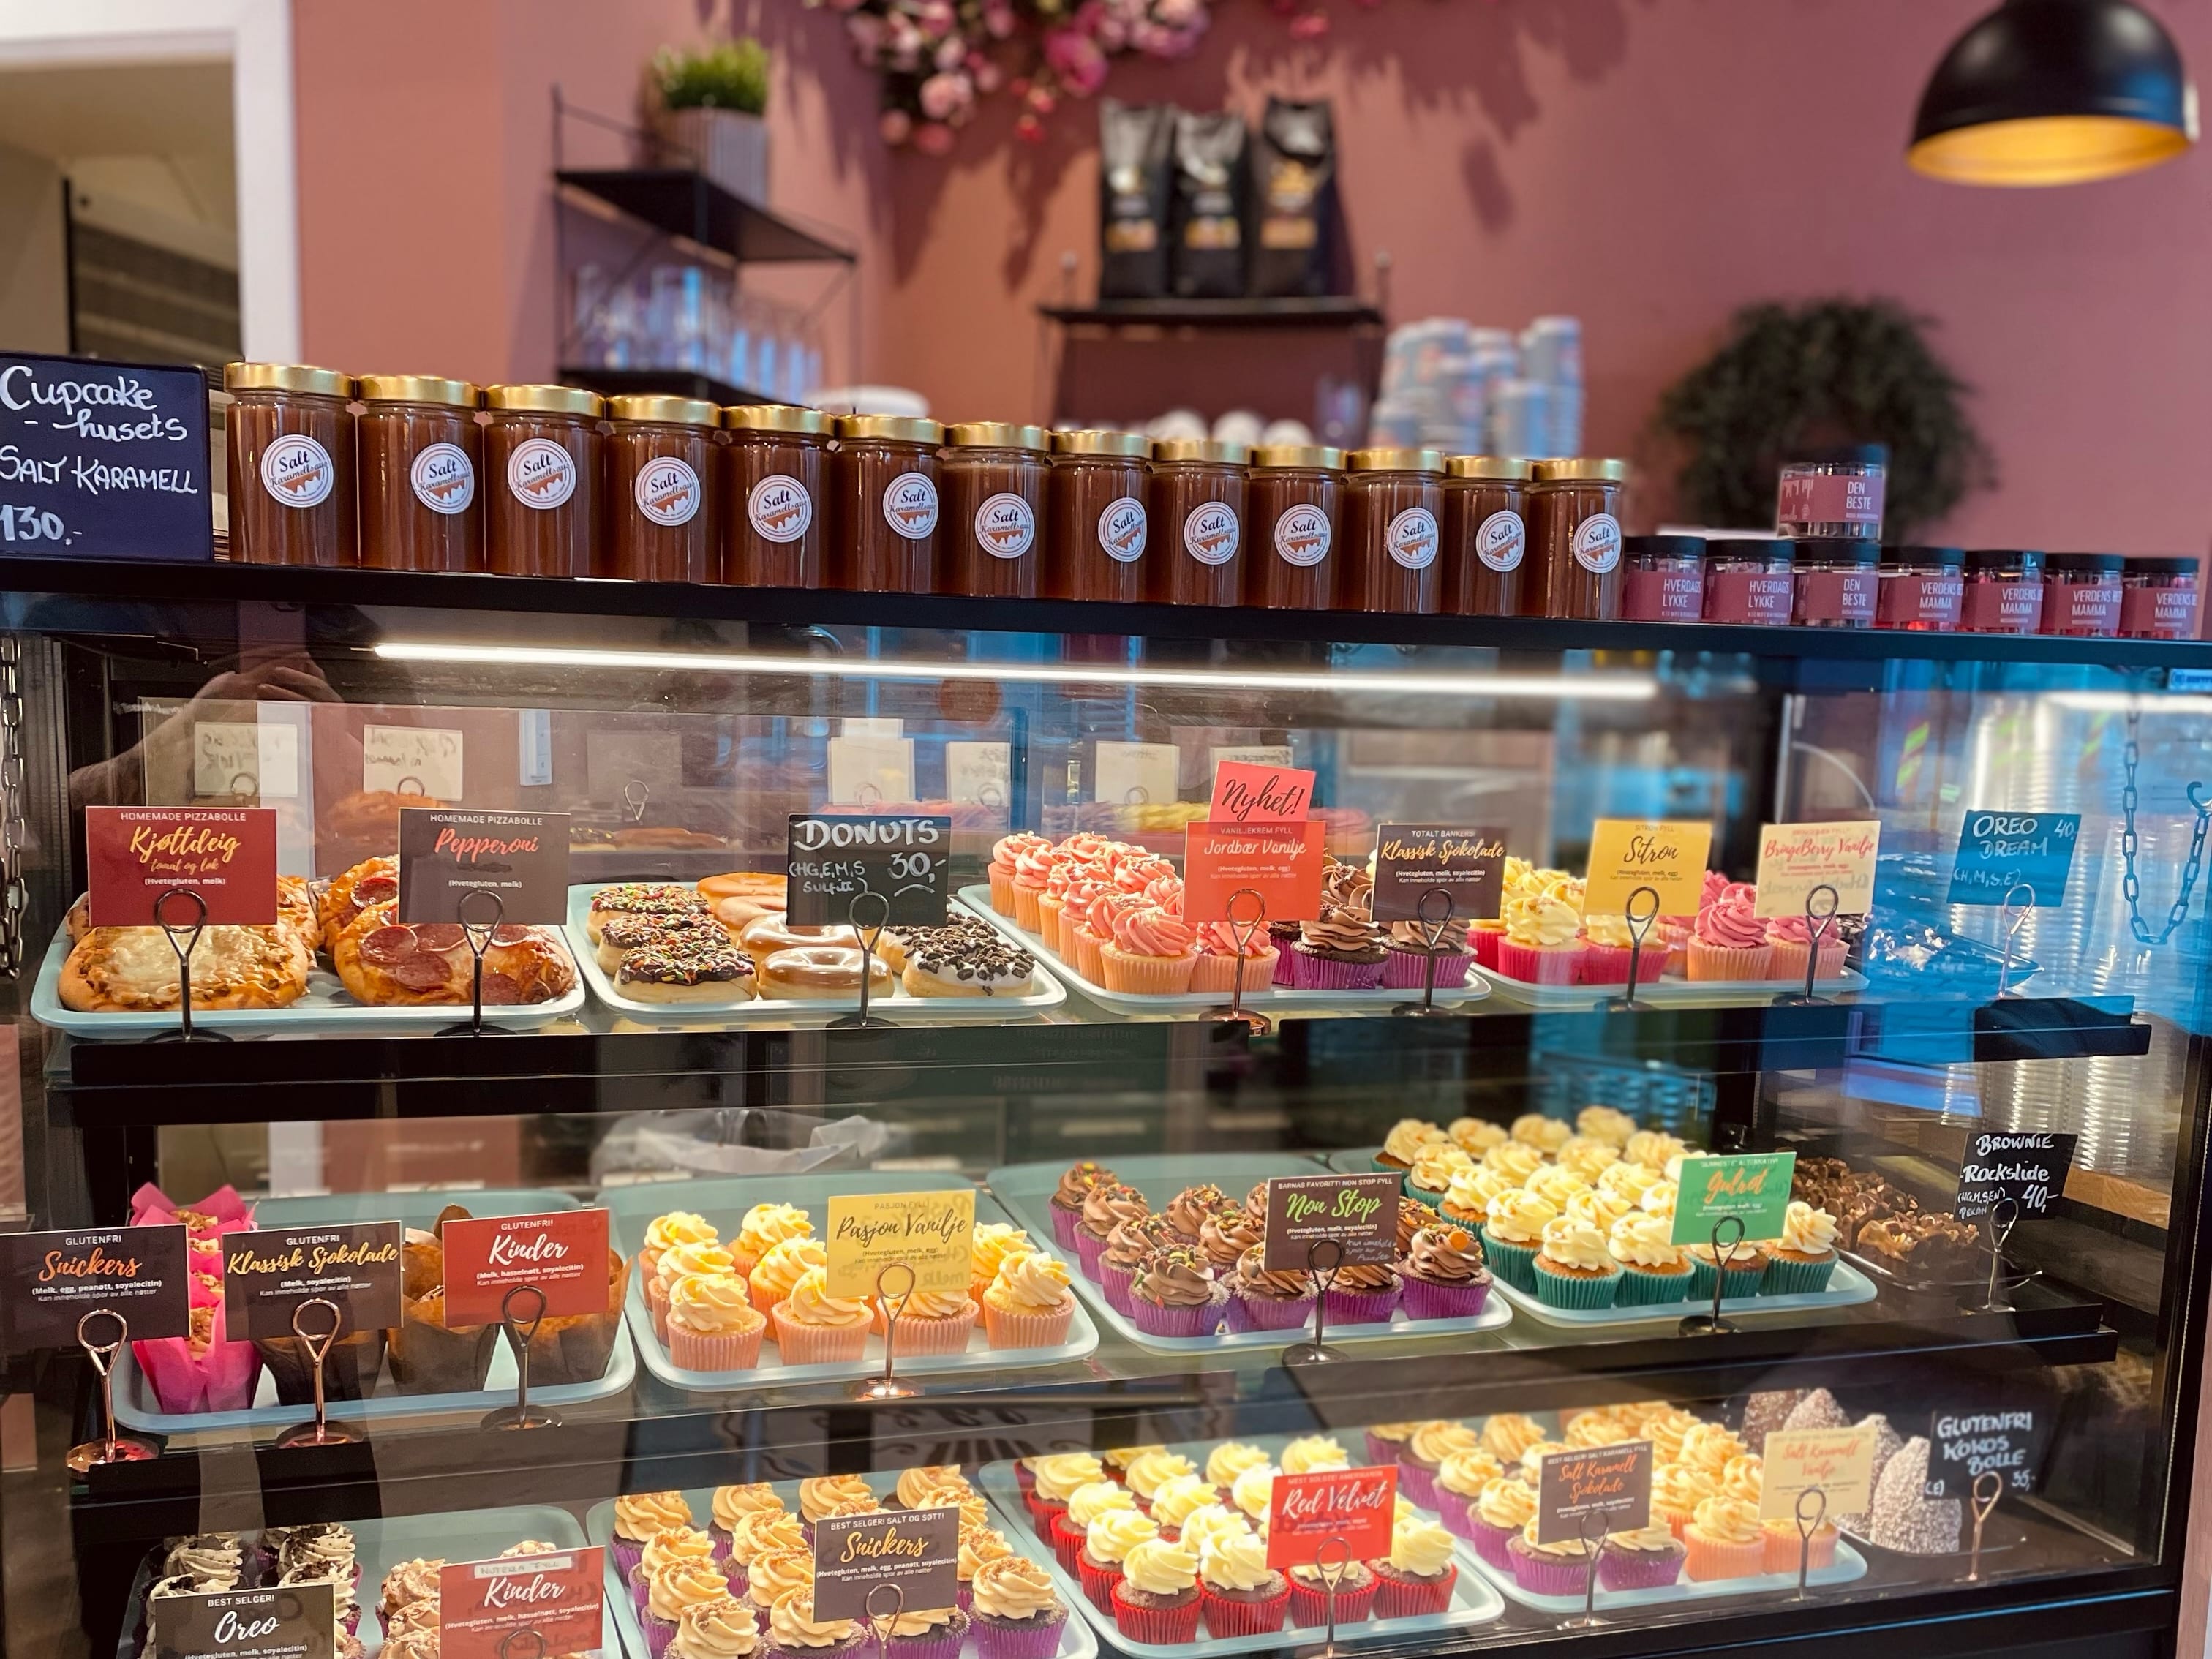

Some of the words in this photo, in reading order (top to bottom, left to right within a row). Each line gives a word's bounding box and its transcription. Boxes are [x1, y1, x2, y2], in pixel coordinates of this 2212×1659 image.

[0, 366, 157, 415] Cupcake
[53, 408, 188, 442] husets
[0, 445, 67, 484] SALT
[71, 456, 198, 495] KARAMELL
[279, 451, 310, 472] Salt
[429, 459, 457, 478] Salt
[524, 454, 552, 476] Salt
[651, 473, 679, 494] Salt
[1848, 481, 1865, 494] DEN
[764, 490, 791, 509] Salt
[900, 489, 926, 503] Salt
[1846, 496, 1872, 510] BESTE
[991, 510, 1019, 524] Salt
[1114, 511, 1135, 533] Salt
[1200, 516, 1225, 533] Salt
[1290, 519, 1316, 533] Salt
[1402, 522, 1426, 538] Salt
[1491, 524, 1513, 544] Salt
[1588, 527, 1610, 544] Salt
[1843, 579, 1860, 591] DEN
[1662, 594, 1688, 608] LYKKE
[1748, 595, 1775, 609] LYKKE
[1842, 592, 1867, 606] BESTE
[1222, 775, 1306, 821] Nyhet!
[121, 812, 181, 821] HOMEMADE
[184, 812, 246, 821] PIZZABOLLE
[430, 814, 485, 824] HOMEMADE
[487, 816, 543, 826] PIZZABOLLE
[1973, 816, 2038, 838] OREO
[130, 826, 241, 864] Kjøttdeig
[434, 827, 539, 864] Pepperoni
[794, 819, 939, 851] DONUTS
[1204, 839, 1258, 855] Jordbær
[1261, 838, 1306, 861] Vanilje
[1381, 839, 1437, 860] Klassisk
[1439, 838, 1505, 865] Sjokolade
[1623, 835, 1679, 865] Sitron
[1979, 837, 2048, 859] DREAM
[145, 878, 200, 886] (Hvetegluten,
[448, 880, 499, 888] (Hvetegluten,
[501, 881, 522, 889] melk)
[1976, 1134, 2054, 1156] BROWNIE
[1963, 1161, 2050, 1182] Rockslide
[874, 1202, 906, 1210] PASJON
[1286, 1193, 1327, 1223] Non
[1331, 1189, 1382, 1223] Stop
[836, 1216, 900, 1248] Pasjon
[905, 1208, 967, 1244] Vanilje
[65, 1235, 122, 1246] GLUTENFRI
[286, 1235, 340, 1246] GLUTENFRI
[489, 1233, 569, 1265] Kinder
[38, 1247, 143, 1282] Snickers
[227, 1248, 304, 1275] Klassisk
[308, 1242, 399, 1275] Sjokolade
[32, 1287, 58, 1295] (Melk,
[115, 1280, 162, 1290] soyalecitin)
[1937, 1412, 2032, 1438] GLUTENFRI
[1943, 1436, 2009, 1461] KOKOS
[1559, 1462, 1584, 1482] Salt
[1587, 1453, 1638, 1478] Karamell
[1967, 1449, 2026, 1476] BOLLE
[1282, 1488, 1324, 1519] Red
[1327, 1480, 1388, 1513] Velvet
[830, 1521, 851, 1530] BEST
[853, 1519, 885, 1528] SELGER!
[887, 1516, 907, 1524] SALT
[922, 1513, 944, 1521] SØTT!
[840, 1527, 929, 1562] Snickers
[208, 1597, 231, 1607] BEST
[236, 1595, 275, 1605] SELGER!
[484, 1573, 565, 1608] Kinder
[214, 1610, 280, 1644] Oreo
